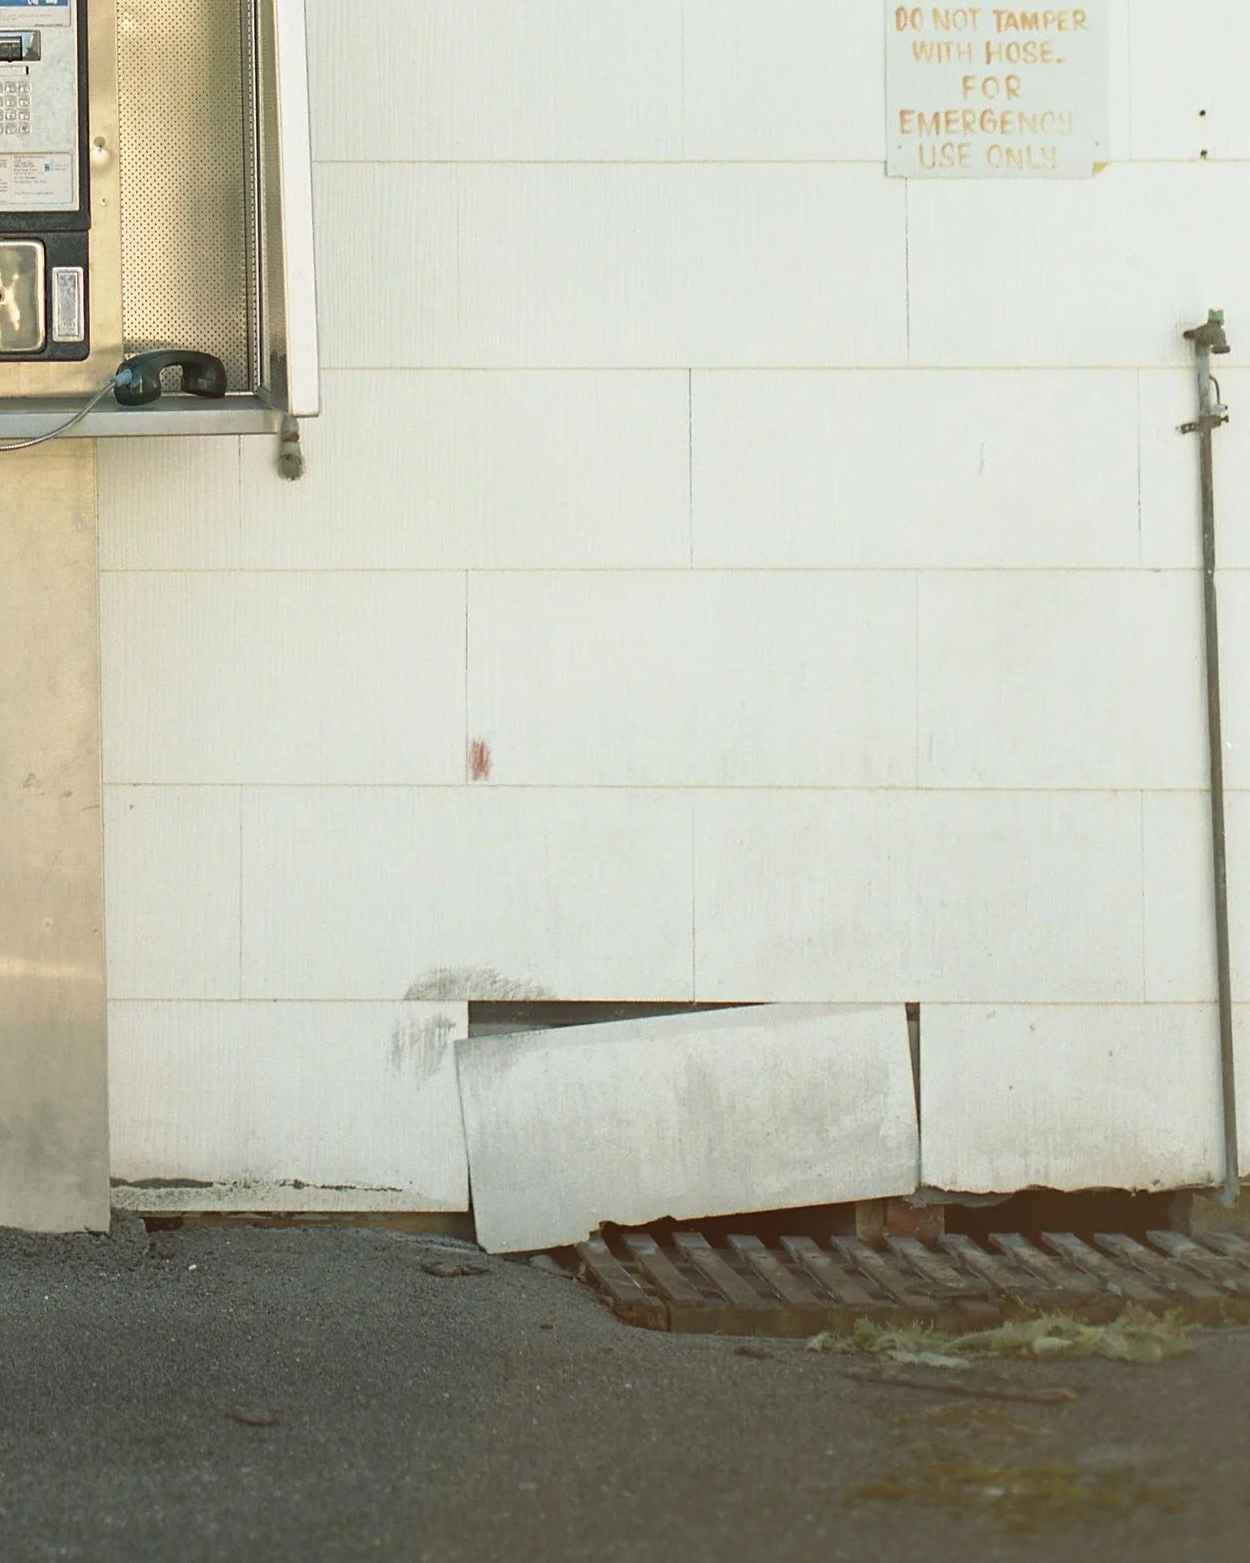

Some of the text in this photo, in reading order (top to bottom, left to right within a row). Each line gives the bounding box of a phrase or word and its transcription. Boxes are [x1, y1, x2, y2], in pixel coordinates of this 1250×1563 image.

[894, 5, 1088, 33] DO NOT TAMPER
[911, 40, 1065, 65] WITH HOSE.
[961, 74, 1022, 101] FOR
[899, 109, 1074, 136] EMERGENCY
[918, 141, 1059, 170] USE ONLY
